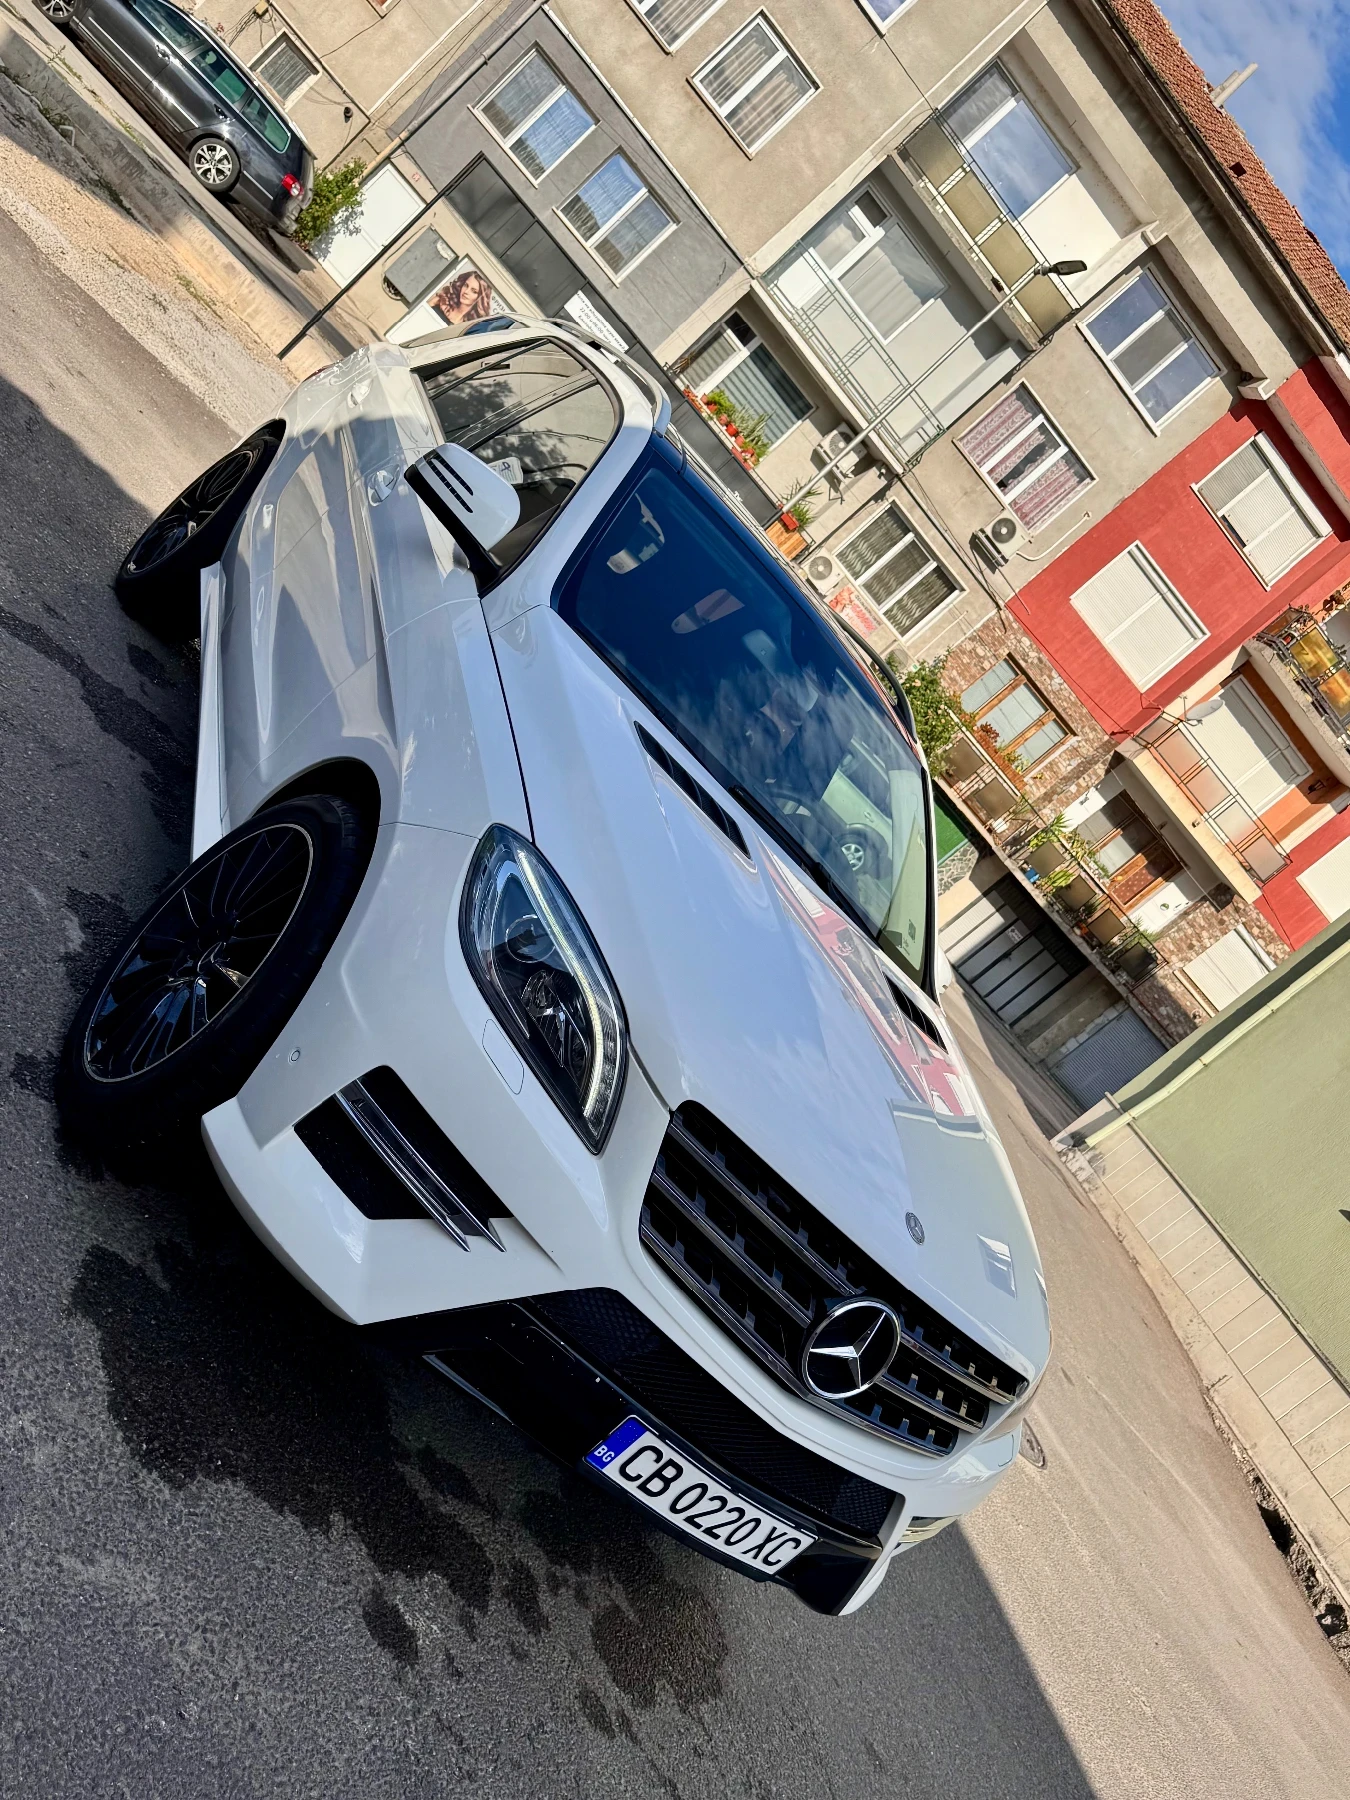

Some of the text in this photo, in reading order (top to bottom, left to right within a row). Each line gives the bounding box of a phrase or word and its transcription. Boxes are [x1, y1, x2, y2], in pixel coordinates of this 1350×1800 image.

[594, 1444, 615, 1463] BG
[618, 1445, 802, 1567] CB 0220 XC
